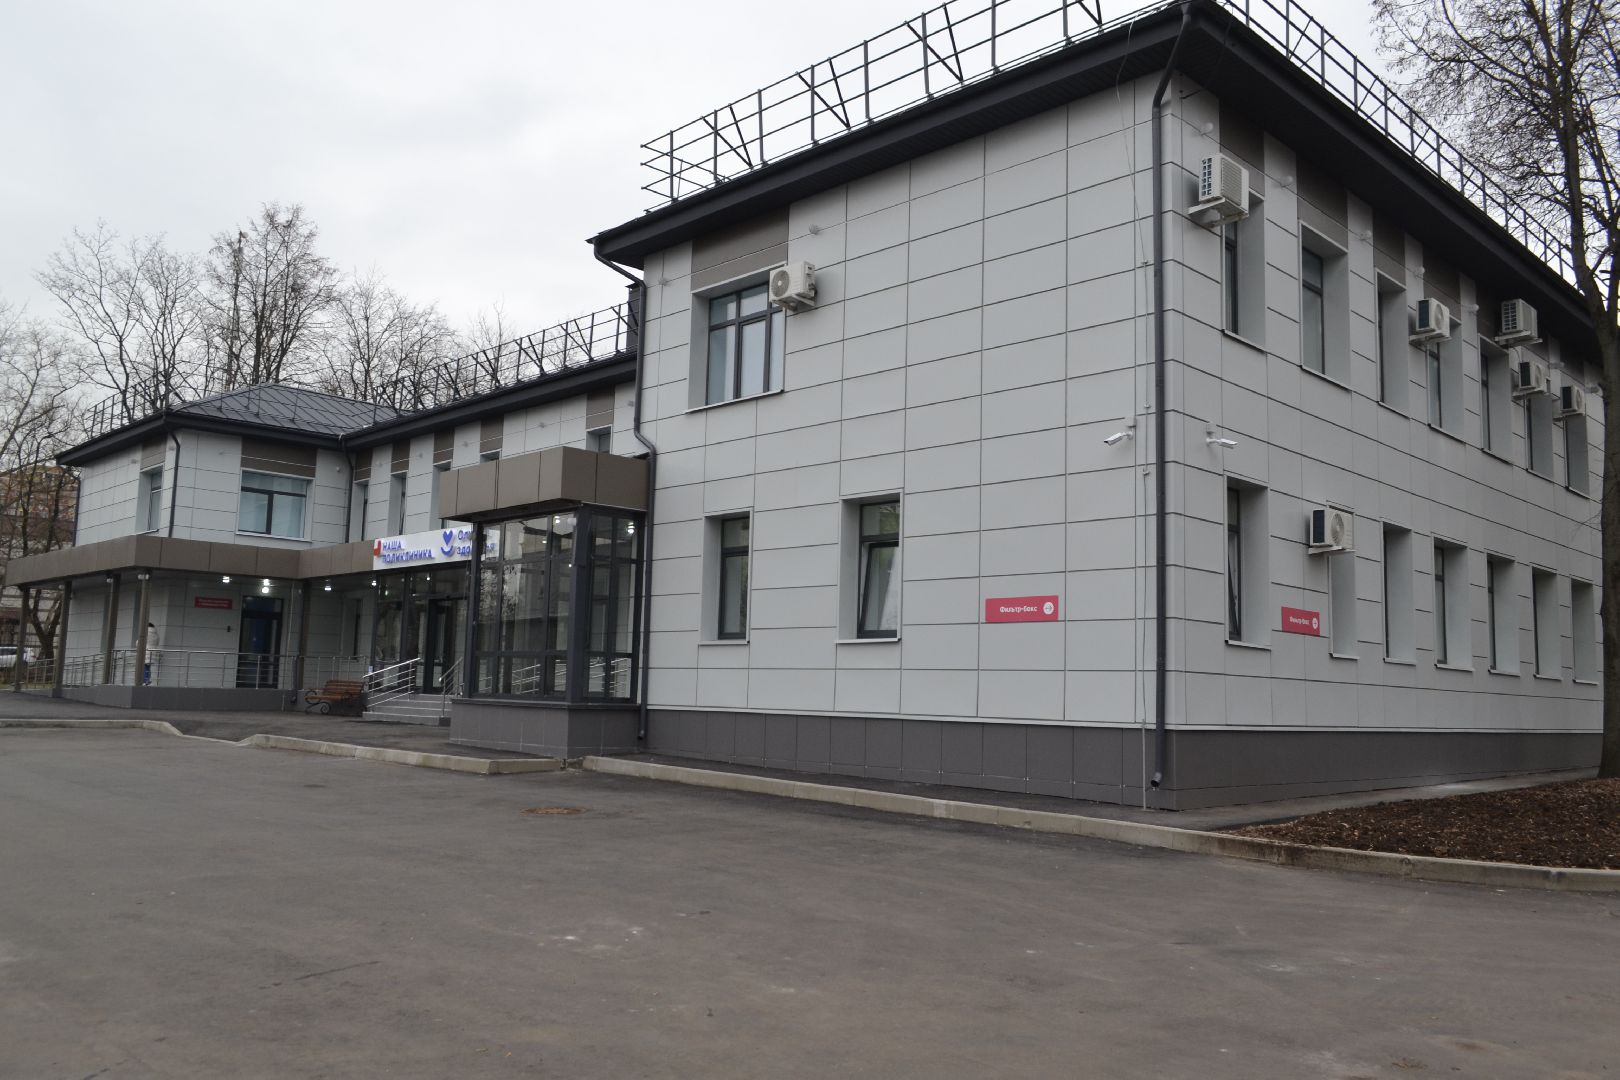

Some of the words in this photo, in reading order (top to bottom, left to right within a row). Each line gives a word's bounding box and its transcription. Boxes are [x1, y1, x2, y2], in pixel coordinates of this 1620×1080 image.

[382, 540, 402, 551] НАША
[382, 549, 434, 563] ПОЛИКЛИНИКА
[999, 605, 1038, 614] Фильтр-бокс
